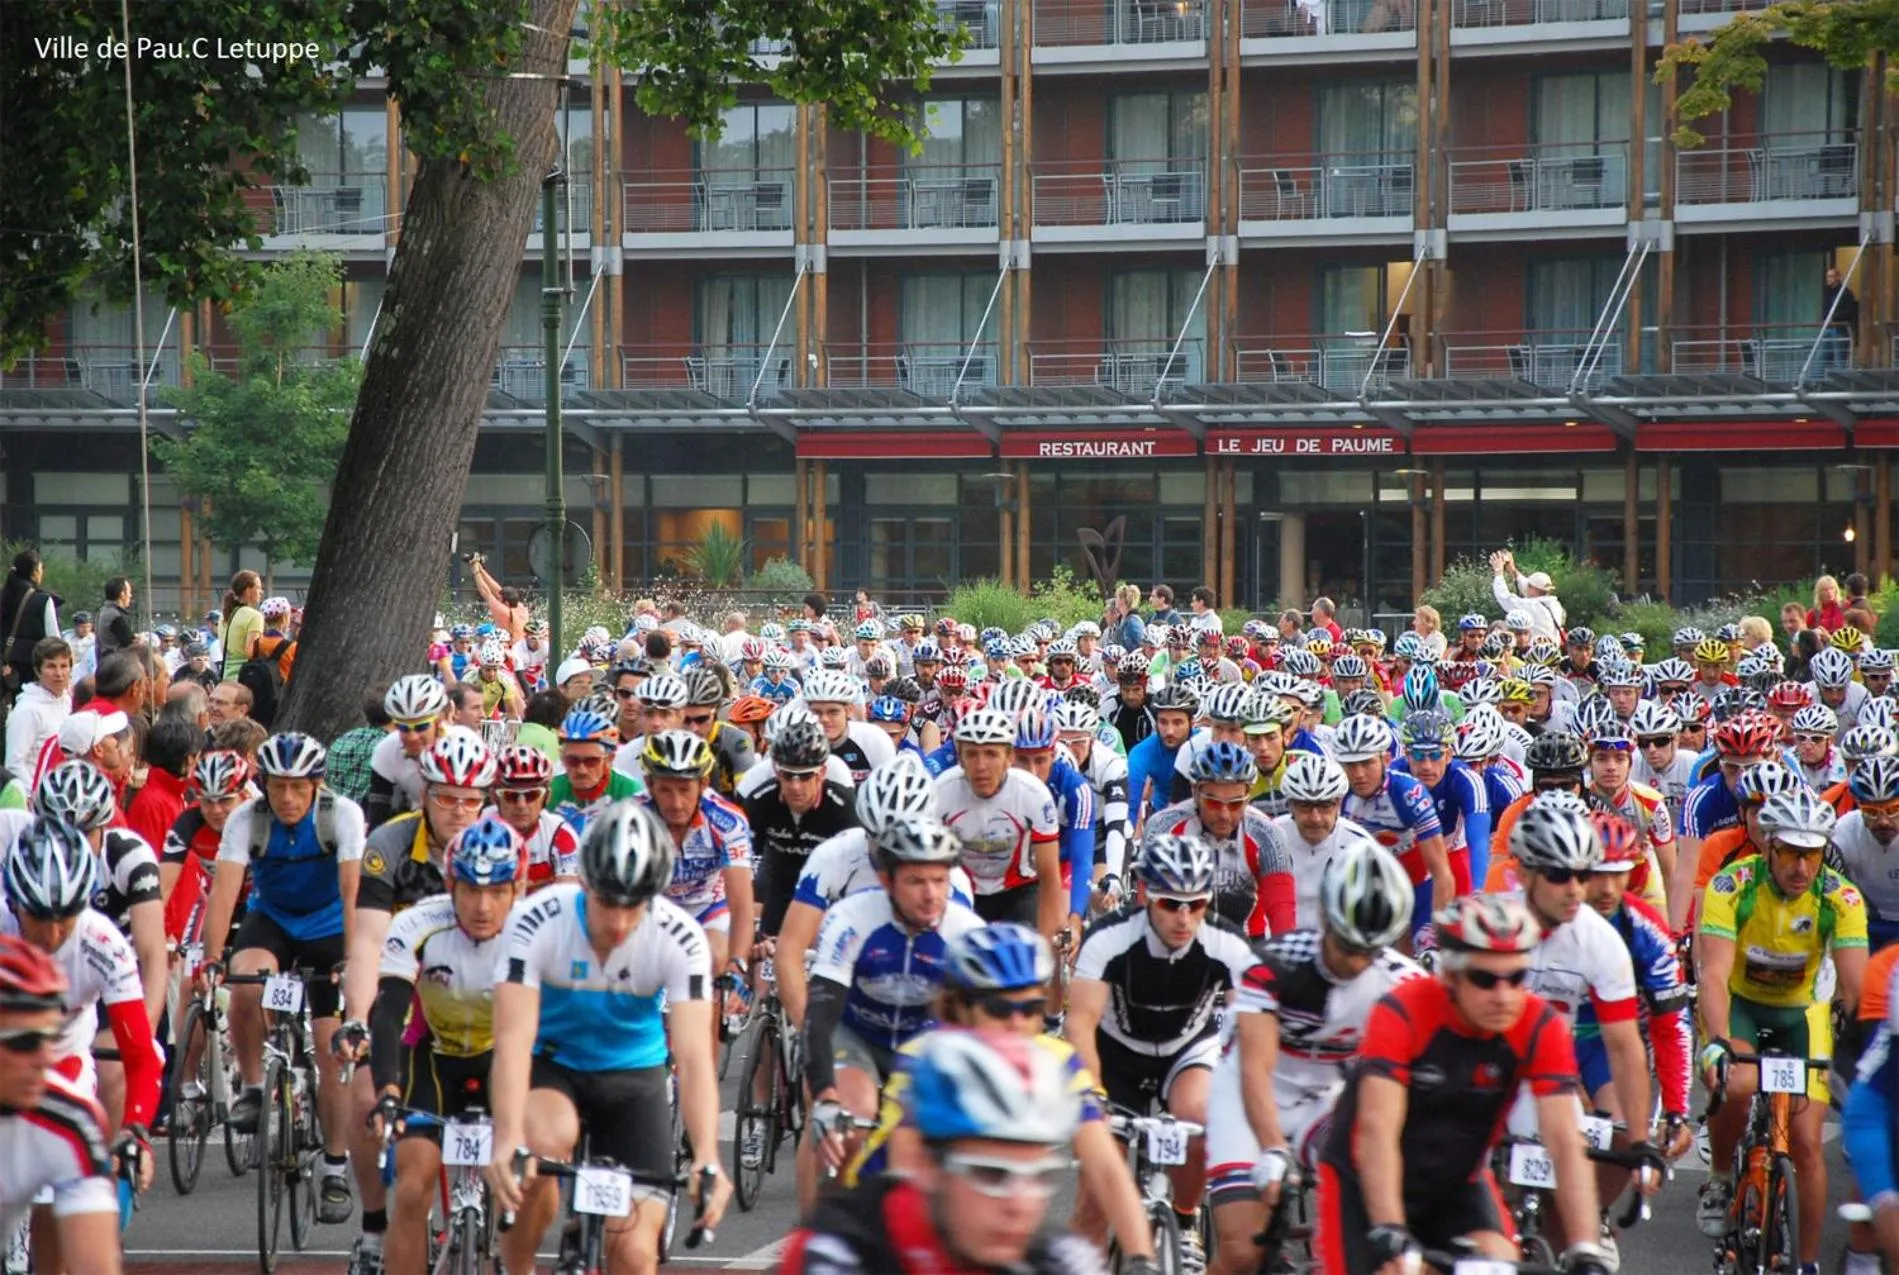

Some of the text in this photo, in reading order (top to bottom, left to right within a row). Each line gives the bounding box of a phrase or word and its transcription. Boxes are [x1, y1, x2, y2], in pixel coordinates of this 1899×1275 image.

[1039, 441, 1155, 456] RESTAURANT
[1218, 438, 1393, 452] LE JEU DE PAUME
[271, 988, 293, 1006] 834
[1772, 1069, 1795, 1088] 785
[455, 1137, 480, 1161] 784
